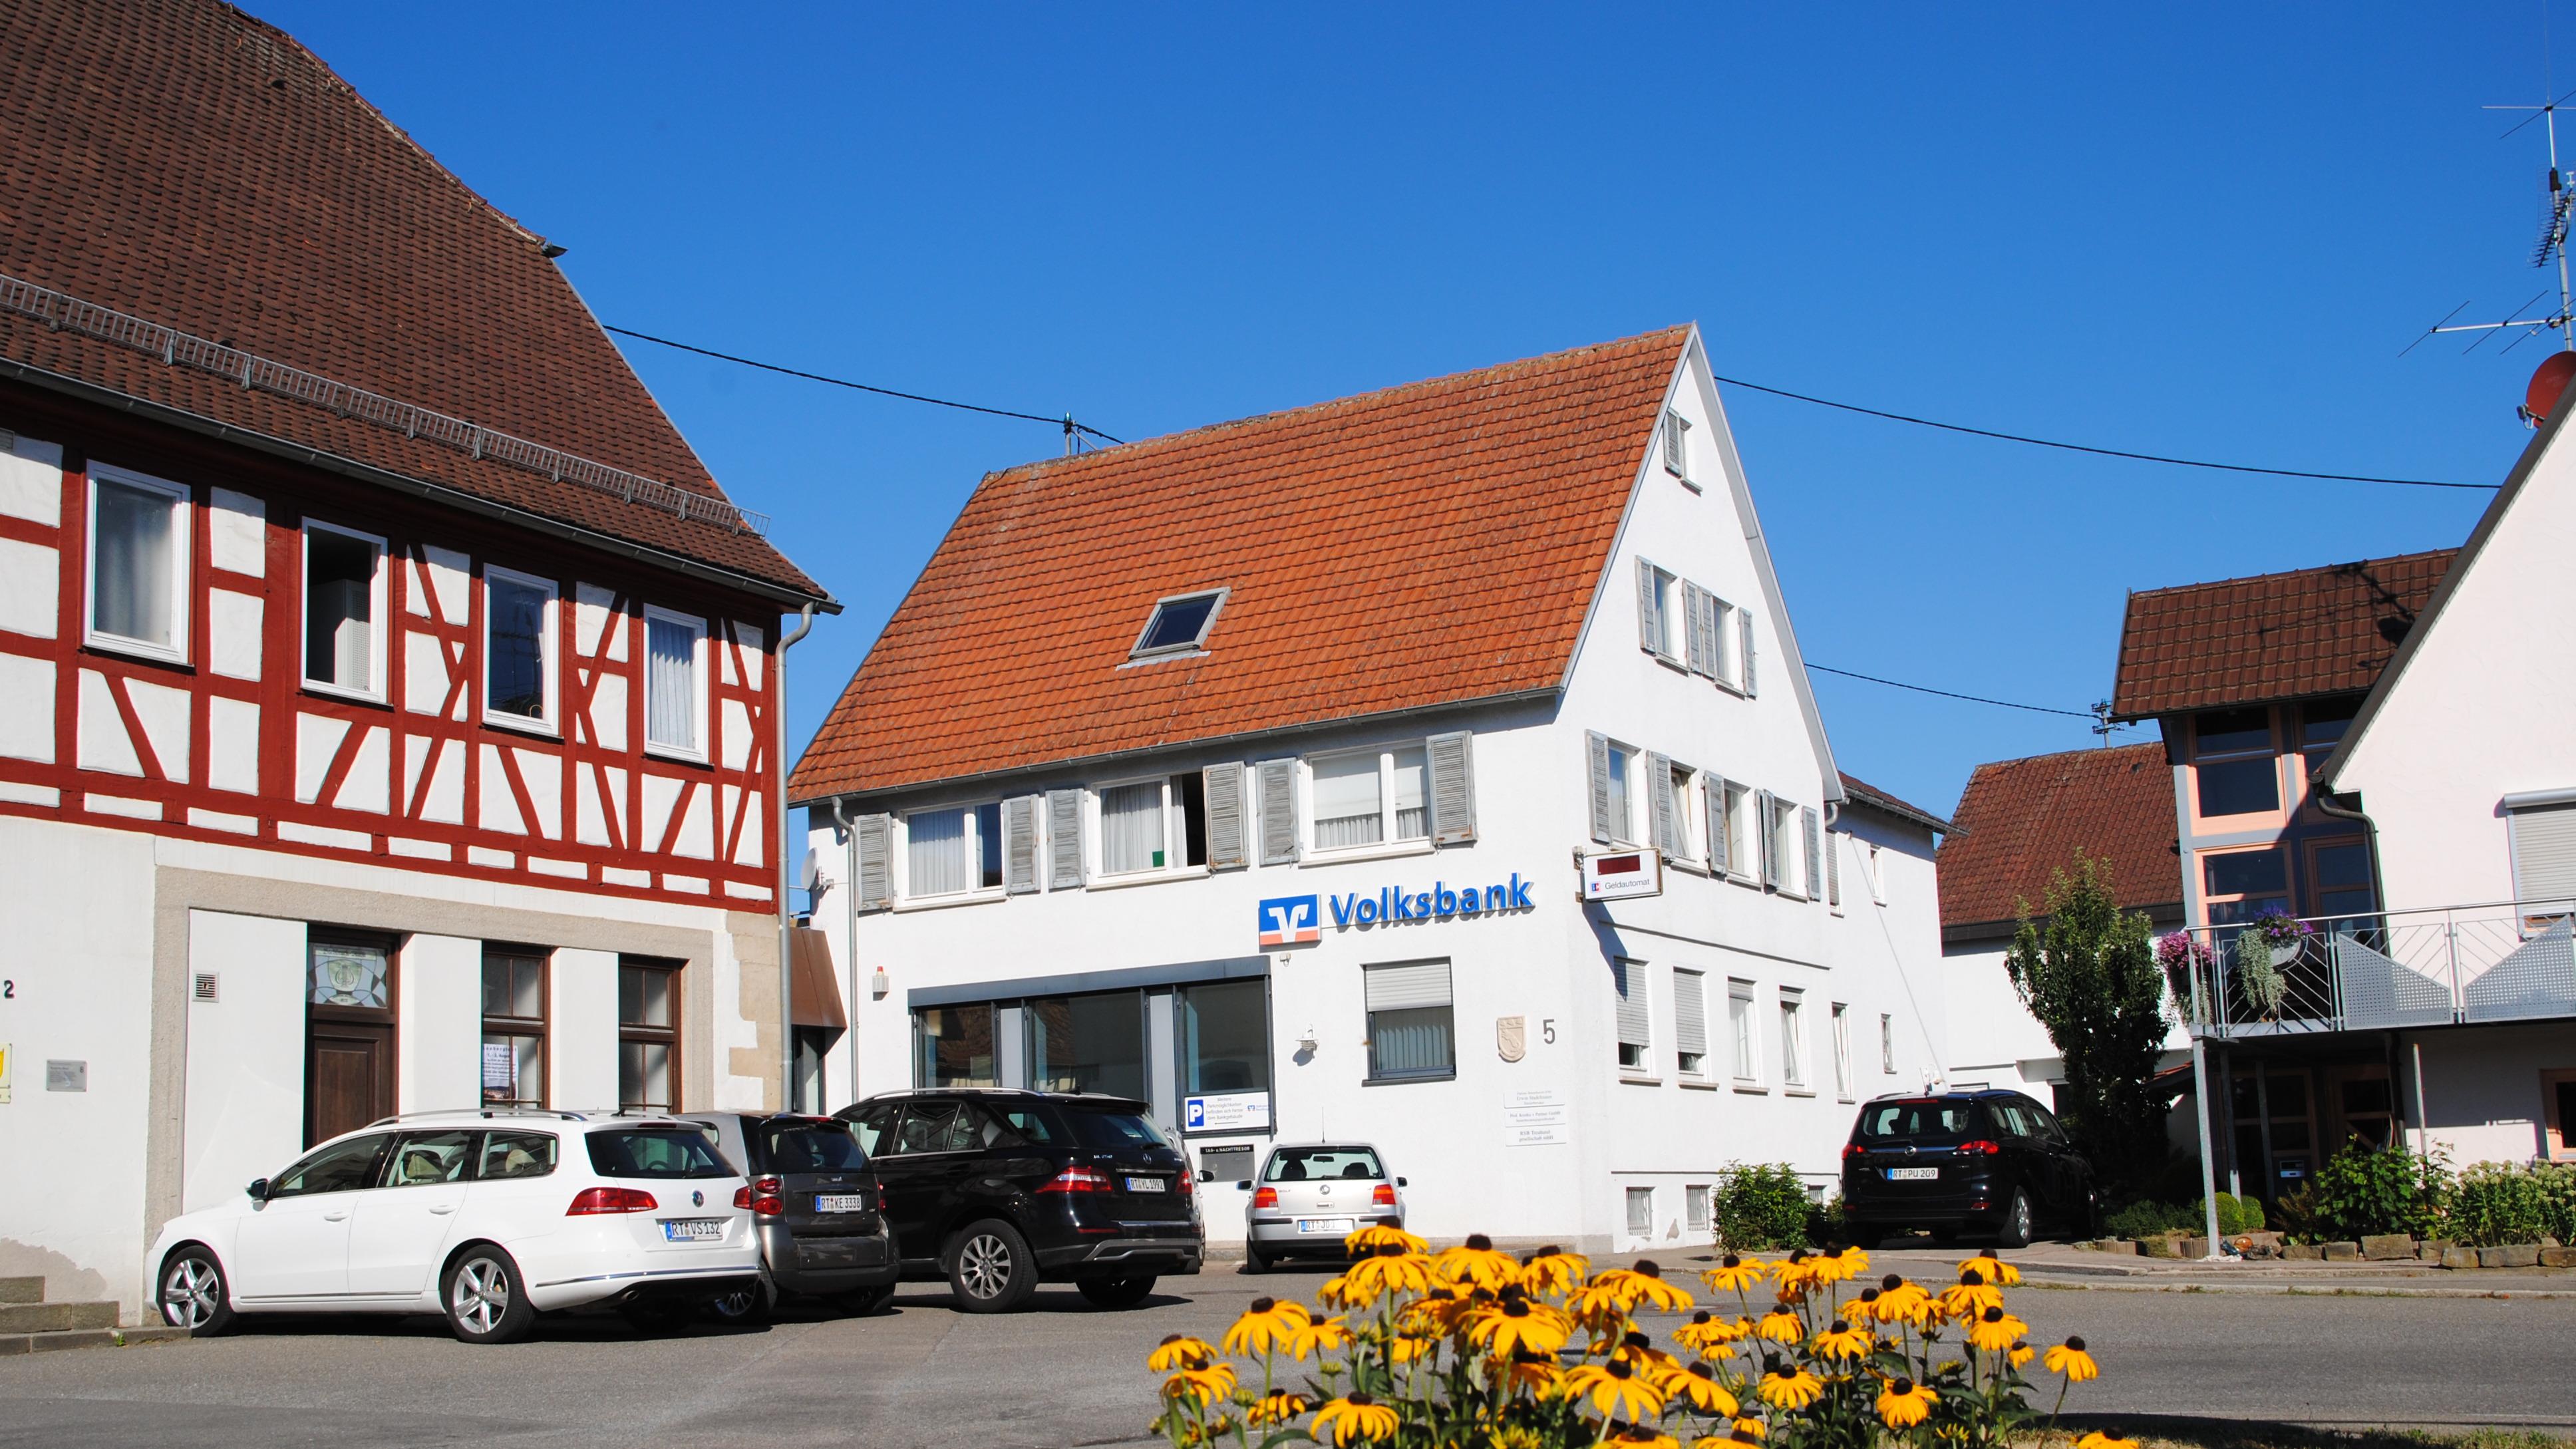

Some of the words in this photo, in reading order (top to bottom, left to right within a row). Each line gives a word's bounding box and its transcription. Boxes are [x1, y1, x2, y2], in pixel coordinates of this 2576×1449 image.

[1605, 879, 1650, 889] Geldautomat
[1331, 872, 1534, 925] Volksbank
[4, 979, 15, 999] 2
[1543, 1019, 1555, 1045] 5
[1190, 1104, 1203, 1122] P
